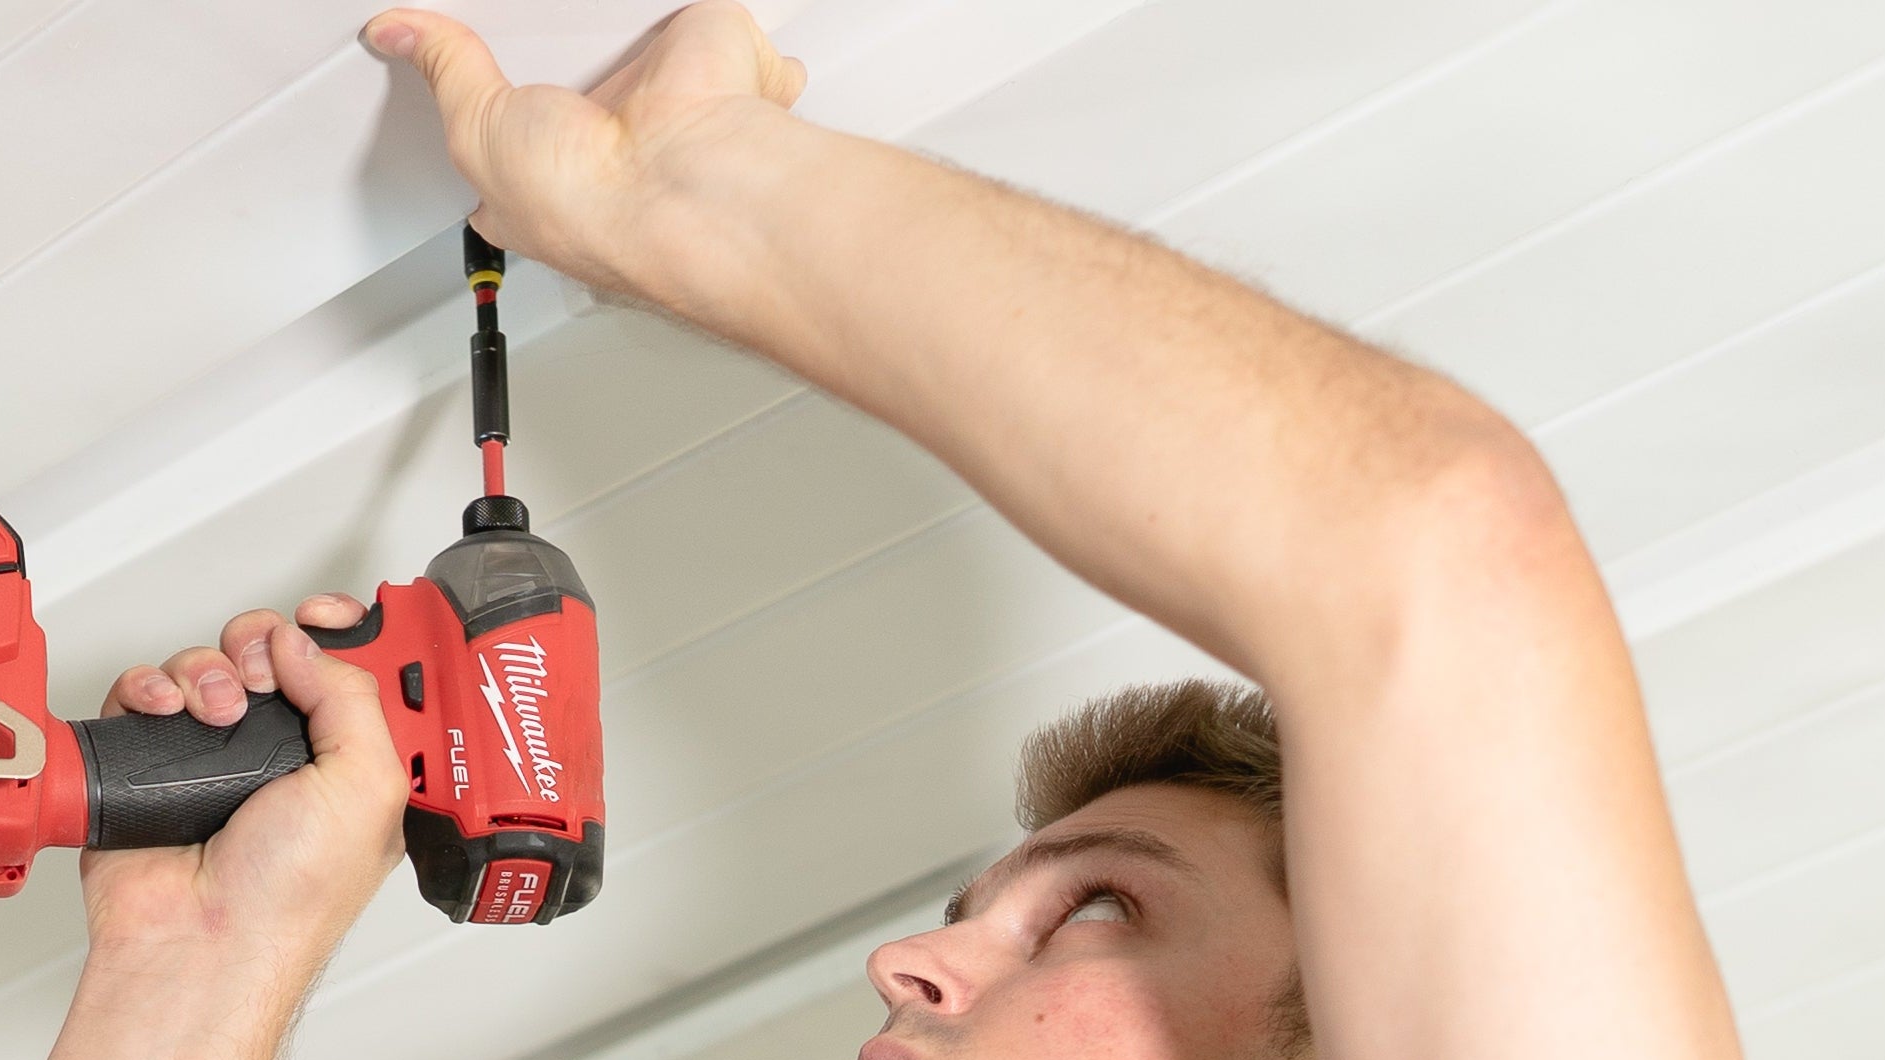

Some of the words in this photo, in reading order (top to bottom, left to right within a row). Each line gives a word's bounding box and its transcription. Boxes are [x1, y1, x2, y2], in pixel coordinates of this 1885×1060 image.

[492, 634, 563, 802] Milwaukee
[447, 728, 469, 800] FUEL
[485, 871, 513, 922] BRUSHLESS
[502, 873, 539, 923] FUEL
